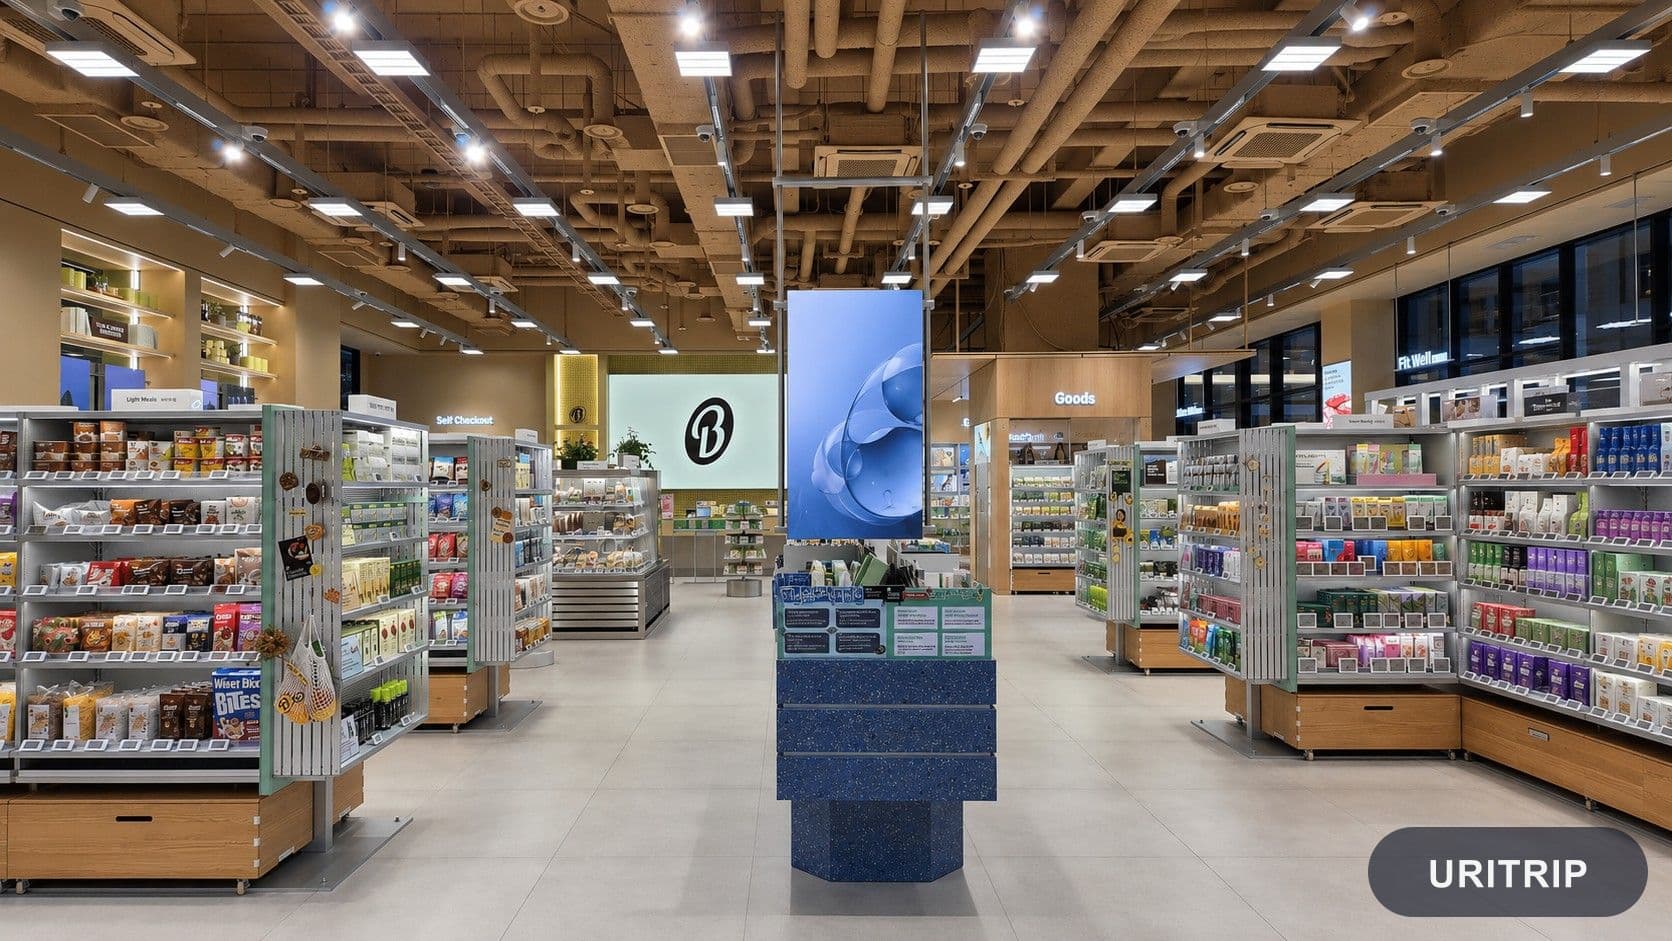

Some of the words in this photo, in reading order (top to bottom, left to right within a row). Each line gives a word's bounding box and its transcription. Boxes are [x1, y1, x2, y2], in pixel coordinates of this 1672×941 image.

[1398, 355, 1411, 370] Fit
[1411, 351, 1432, 368] Well
[1055, 391, 1096, 405] Goods
[436, 415, 454, 425] Self
[454, 415, 494, 425] Checkout
[689, 402, 727, 460] B
